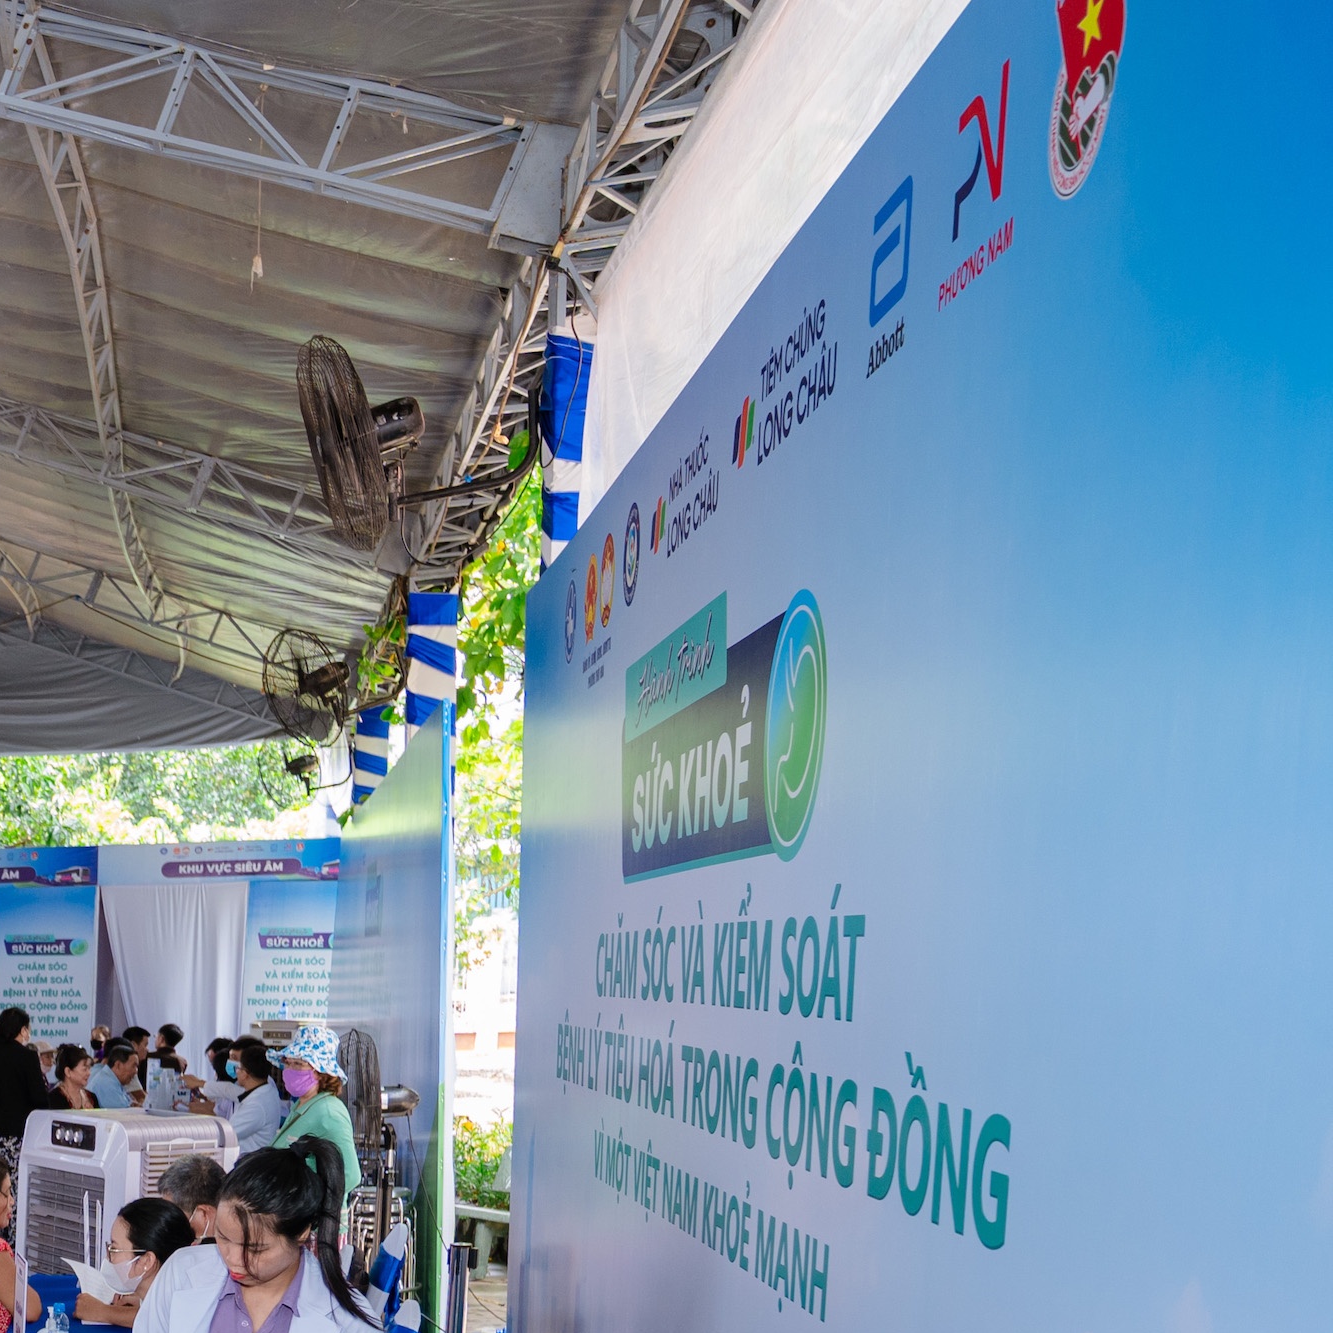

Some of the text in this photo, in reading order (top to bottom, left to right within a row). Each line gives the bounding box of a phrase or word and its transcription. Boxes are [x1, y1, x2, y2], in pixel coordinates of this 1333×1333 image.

[938, 216, 1013, 312] PHƯƠNG NAM
[761, 345, 783, 402] TIÊM
[866, 316, 905, 379] Abbott
[758, 341, 837, 466] LONG CHÂU
[669, 426, 709, 504] NHÀ THUỐC
[667, 468, 719, 559] LONG CHÂU
[635, 641, 675, 728] Hành
[632, 684, 752, 853] SỨC KHOẺ
[1, 867, 19, 880] ÂM
[179, 859, 283, 875] KHU VỰC SIÊU ÂM
[11, 942, 65, 953] SỨC KHOẺ
[266, 935, 324, 947] SỨC KHOẺ
[595, 883, 865, 1023] CHĂM SÓC VÀ KIỂM SOÁT
[12, 975, 23, 984] VÀ
[50, 975, 74, 984] SOÁT
[29, 1001, 57, 1012] CỘNG
[60, 1001, 88, 1010] ĐỒNG
[41, 988, 58, 997] TIÊU
[38, 1015, 55, 1025] VIỆT
[41, 1030, 68, 1039] MẠNH
[556, 1008, 1012, 1250] BỆNH LÝ TIÊU HOÁ TRONG CỘNG ĐỒNG
[594, 1118, 830, 1322] VÌ MỘT VIỆT NAM KHOẺ MẠNH
